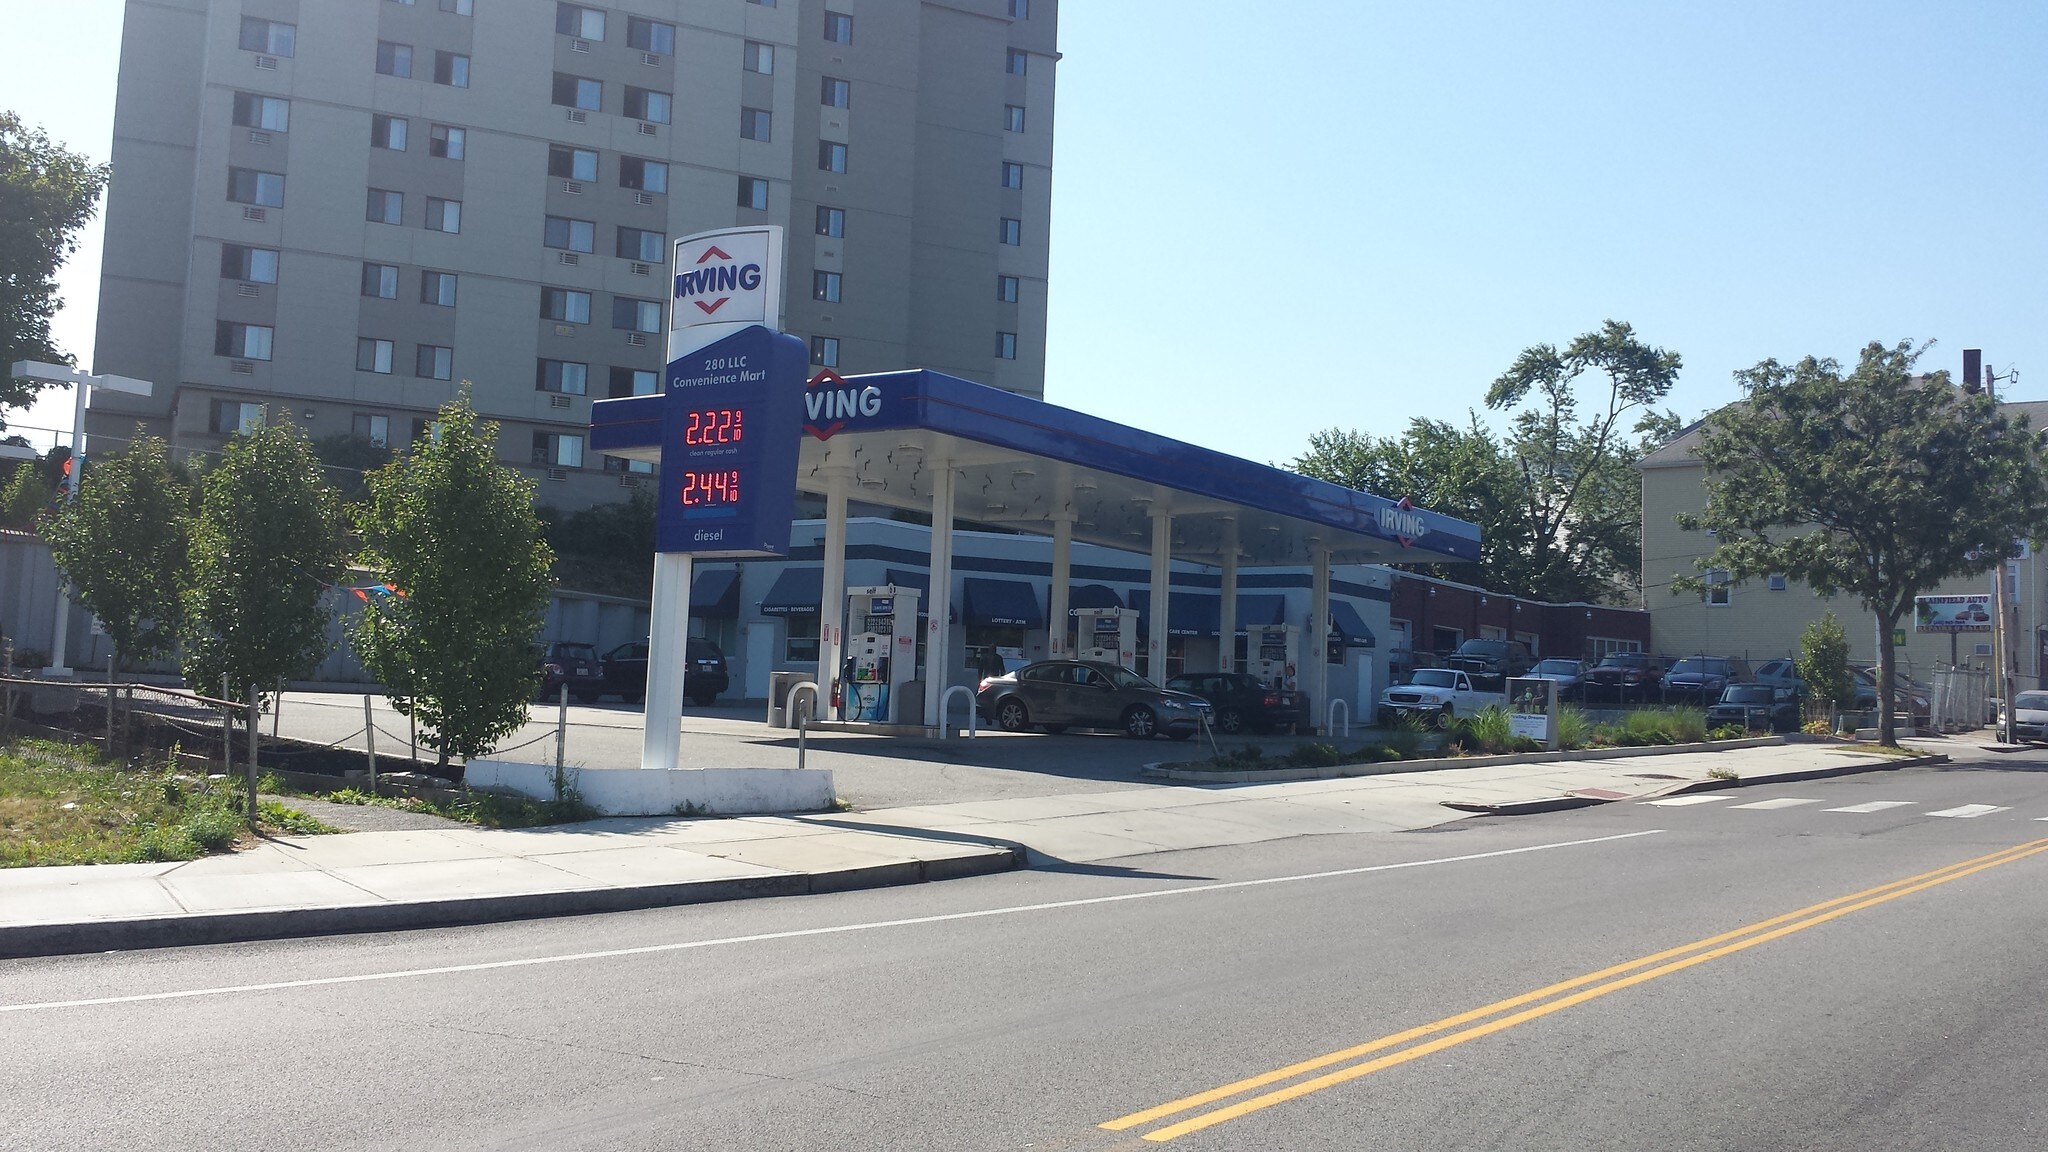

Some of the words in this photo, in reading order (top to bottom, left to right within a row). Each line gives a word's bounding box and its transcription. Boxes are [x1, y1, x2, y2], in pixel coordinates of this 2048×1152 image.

[675, 264, 760, 298] IRVING
[705, 358, 725, 371] 280
[728, 355, 747, 369] LLC
[673, 373, 737, 388] Convenience
[739, 369, 766, 382] Mart
[805, 386, 881, 420] VING
[686, 410, 731, 445] 2.22
[689, 449, 704, 457] clean
[704, 448, 724, 457] regular
[683, 472, 728, 505] 2.44
[694, 528, 723, 541] diesel
[1381, 507, 1424, 536] IRVING
